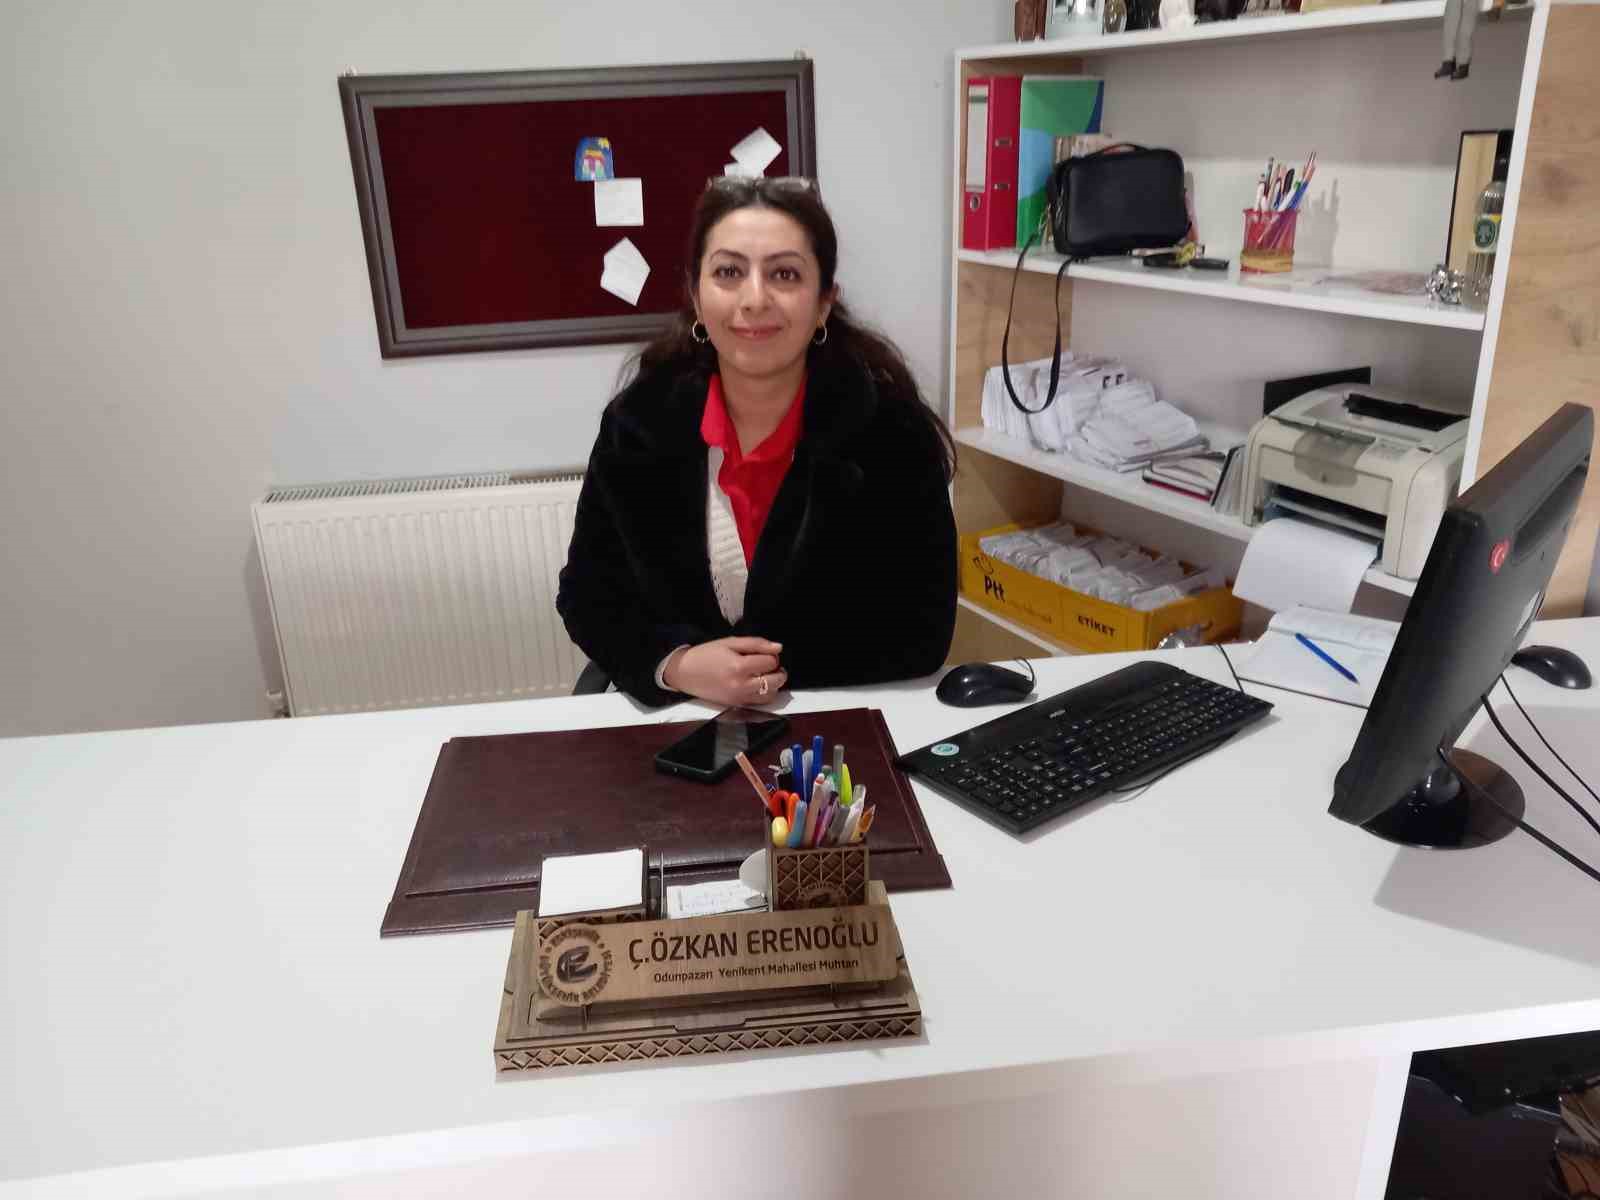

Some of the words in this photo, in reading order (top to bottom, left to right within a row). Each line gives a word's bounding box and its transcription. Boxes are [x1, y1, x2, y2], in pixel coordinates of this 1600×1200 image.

[629, 931, 738, 970] Ç.ÖZKAN
[746, 916, 879, 955] ERENOĞLU
[719, 964, 765, 978] Yenikent
[768, 960, 817, 975] Mahallesi
